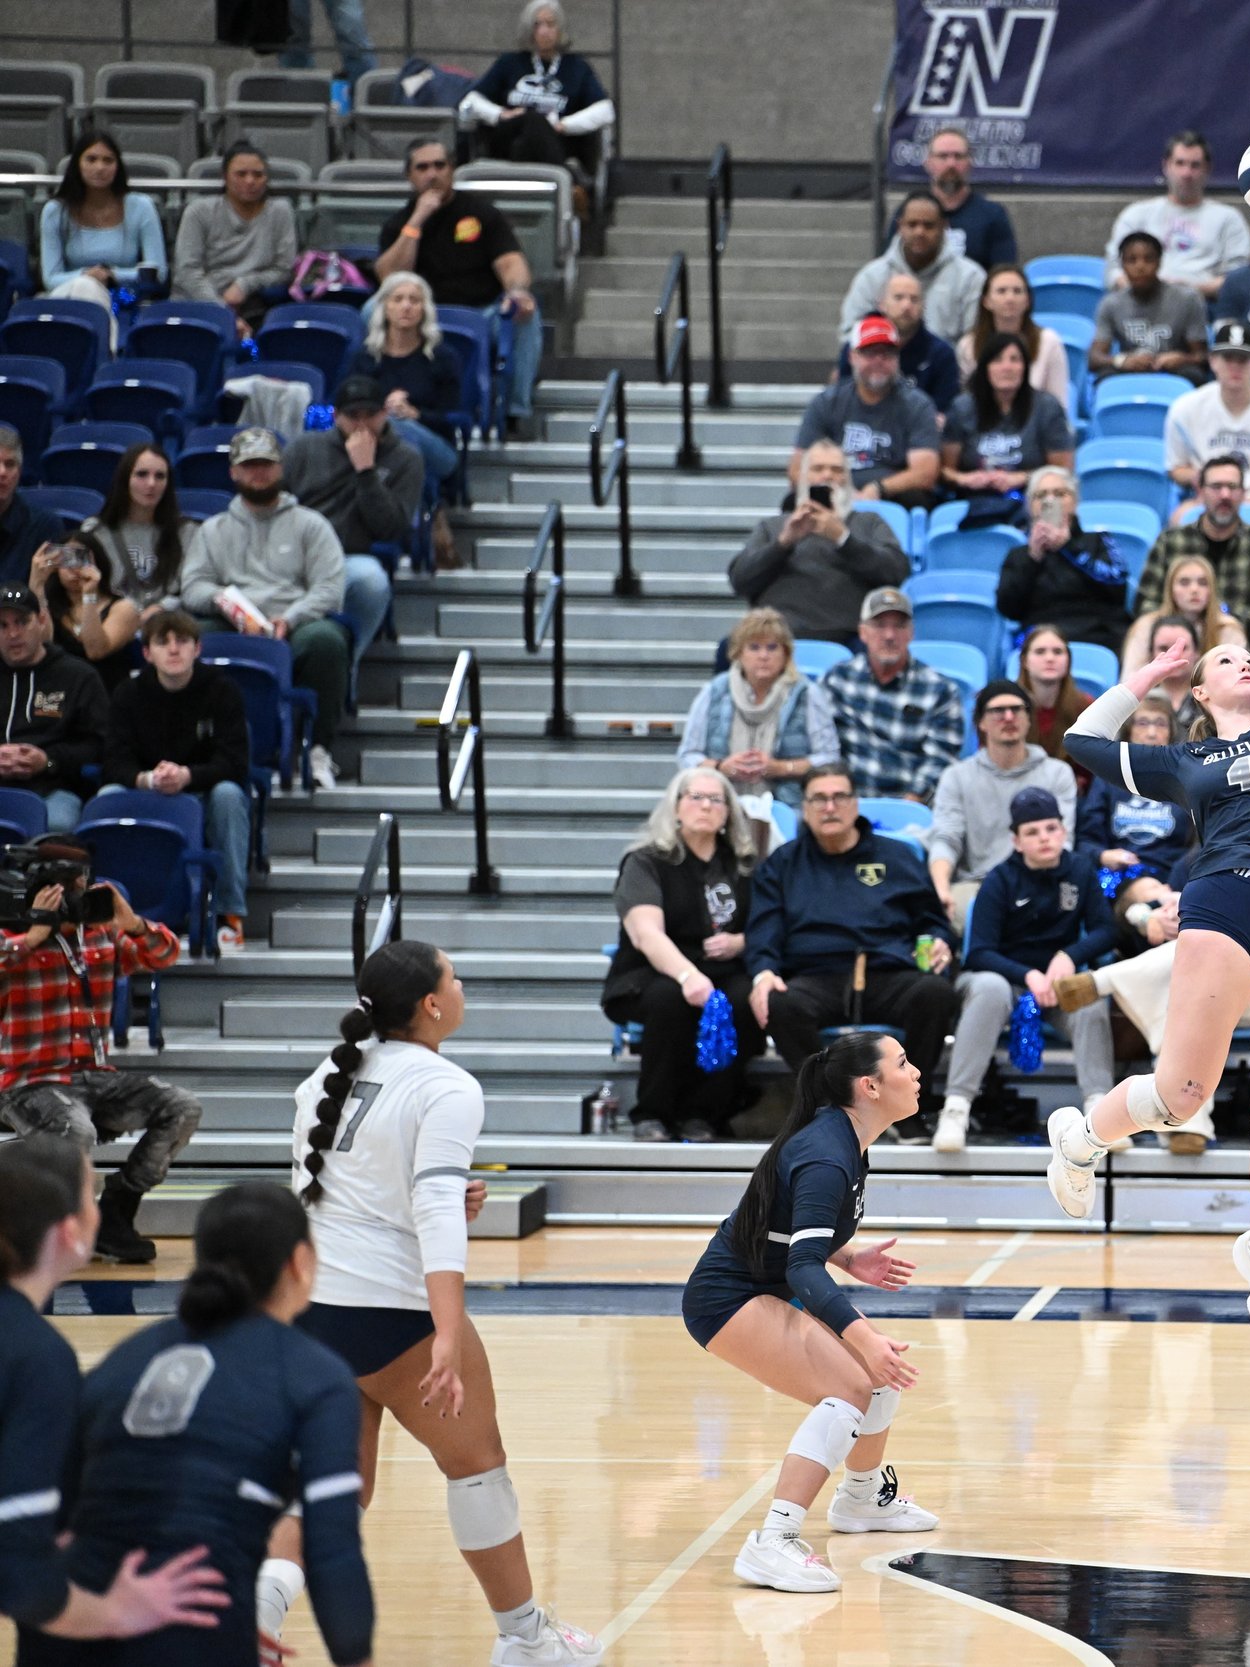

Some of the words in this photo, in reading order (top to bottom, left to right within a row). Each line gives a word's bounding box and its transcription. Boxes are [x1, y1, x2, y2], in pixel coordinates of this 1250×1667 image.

[908, 9, 1058, 119] N
[336, 1081, 384, 1152] 7
[122, 1343, 216, 1437] 8
